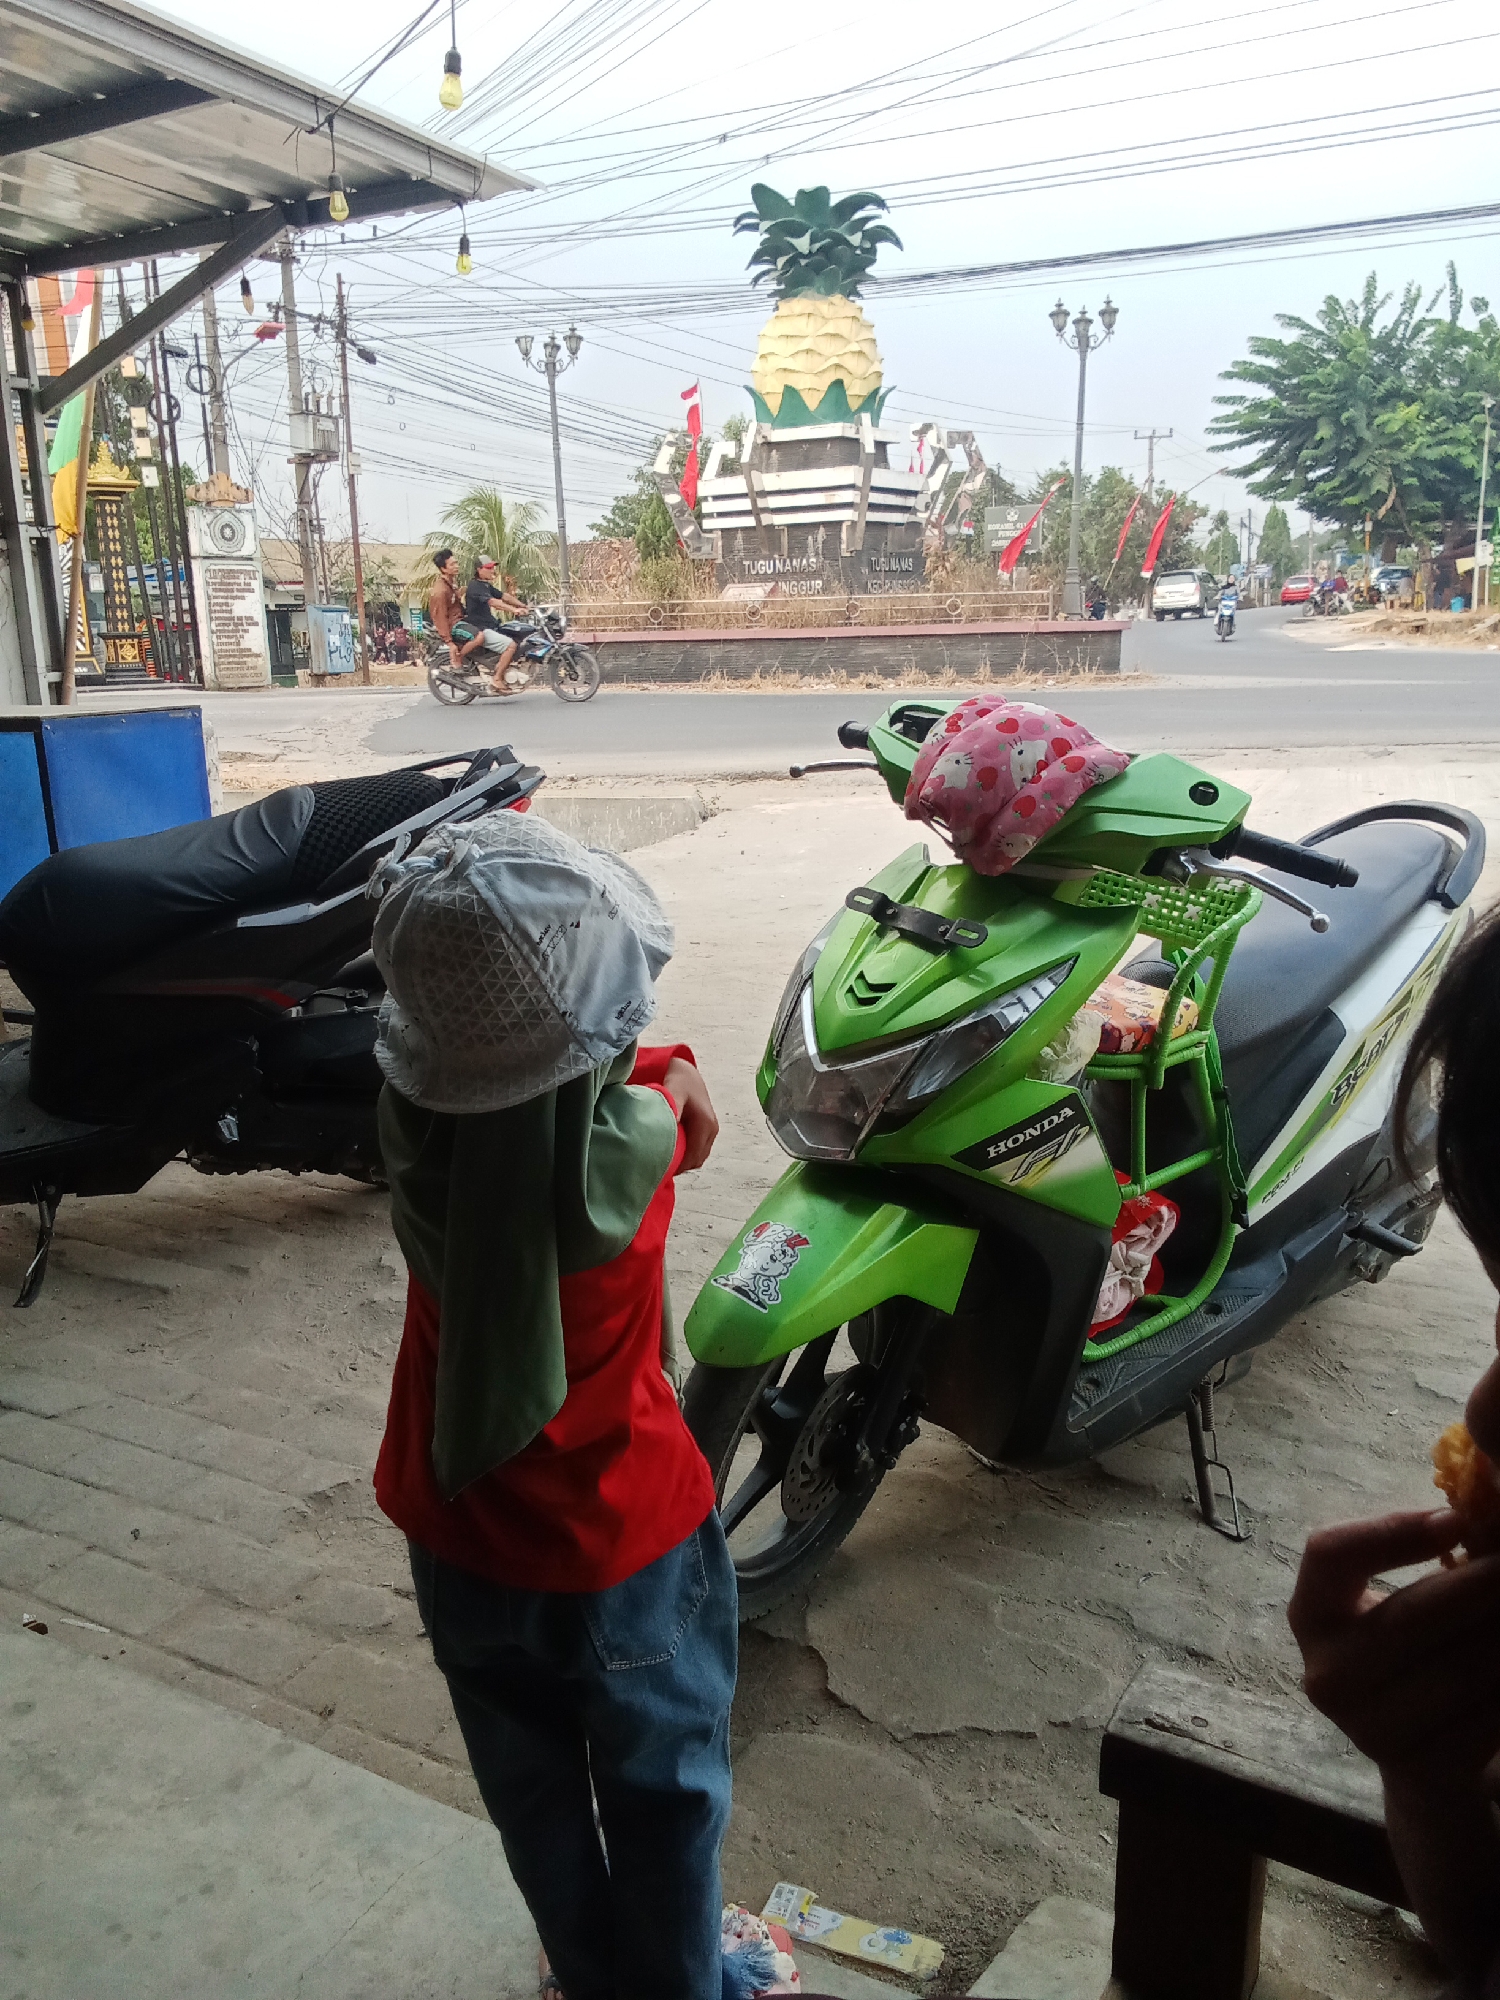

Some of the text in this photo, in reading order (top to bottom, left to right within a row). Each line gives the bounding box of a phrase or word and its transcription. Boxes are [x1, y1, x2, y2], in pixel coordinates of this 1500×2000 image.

[742, 557, 817, 575] TUGU NANAS
[870, 557, 889, 571] TUGU
[778, 579, 823, 596] NGGUR
[986, 1106, 1076, 1159] HONDA
